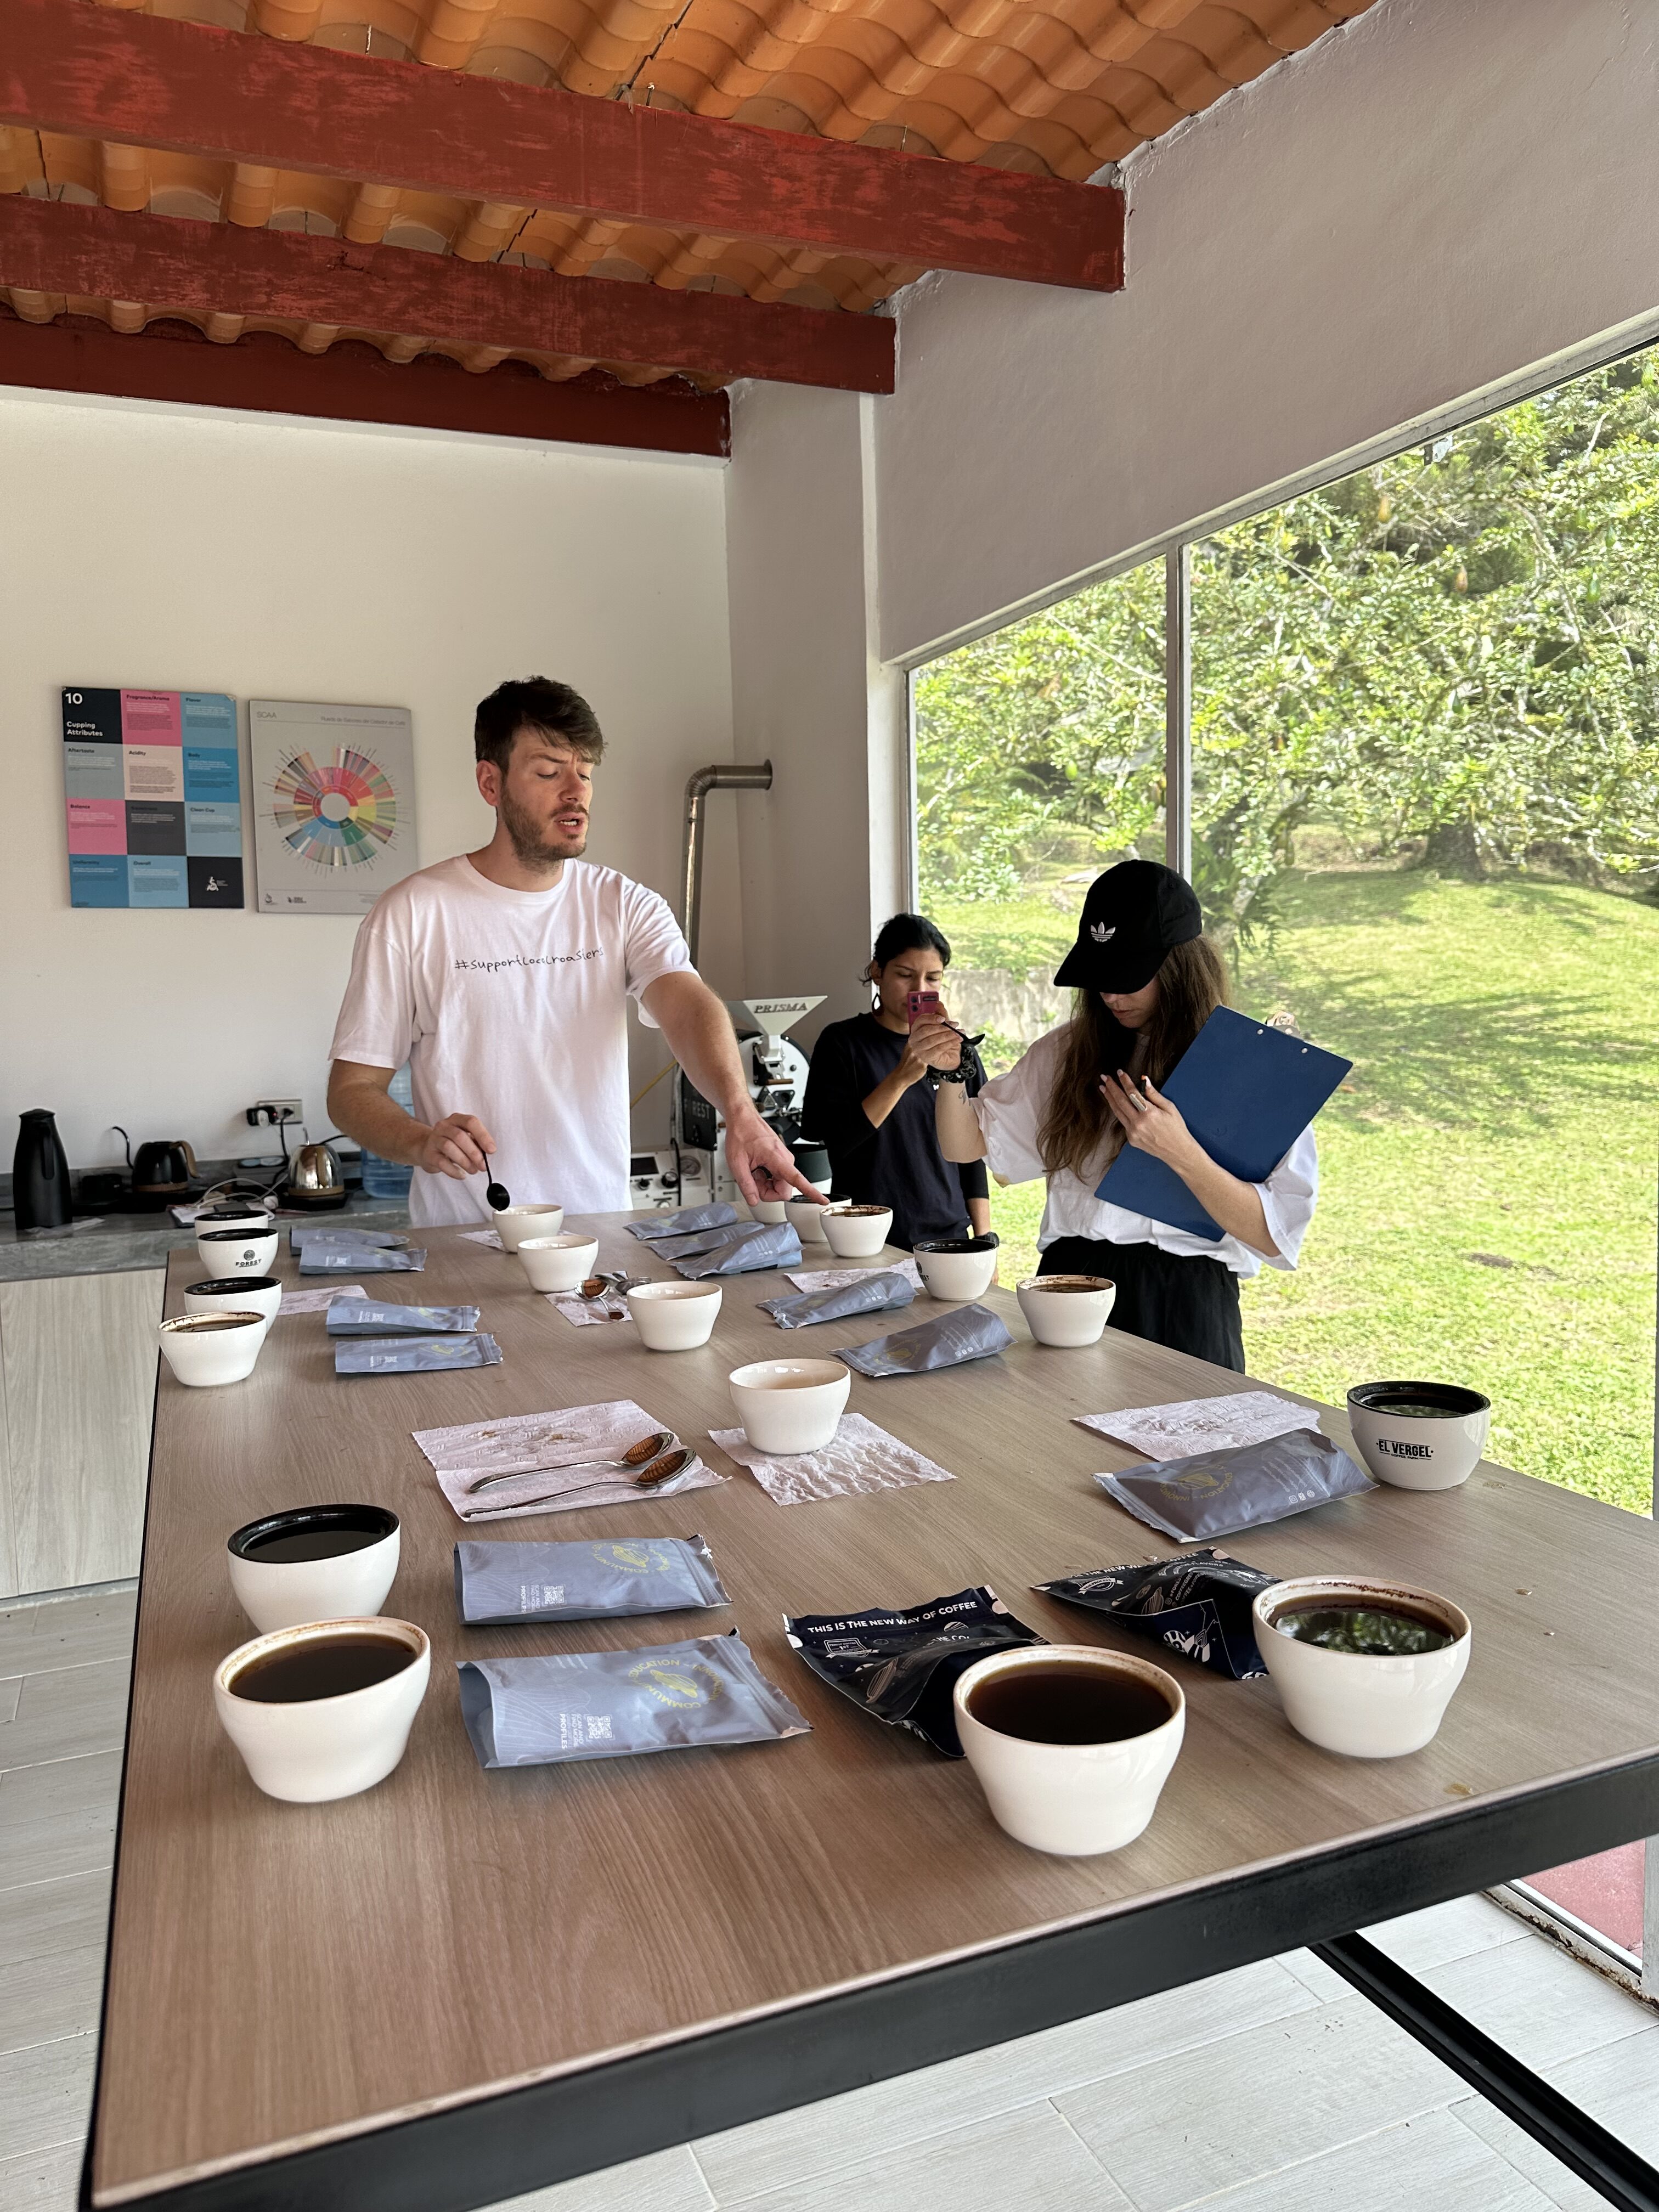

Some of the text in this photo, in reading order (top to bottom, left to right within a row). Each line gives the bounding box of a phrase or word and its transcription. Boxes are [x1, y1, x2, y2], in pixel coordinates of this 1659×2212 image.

[65, 692, 83, 704] 10
[66, 720, 95, 730] Cupping
[67, 729, 104, 737] Attributes
[754, 1002, 808, 1013] PRISMA
[1379, 1440, 1431, 1458] EL VERGEL
[807, 1624, 833, 1633] THIS
[834, 1622, 846, 1630] IS
[846, 1621, 868, 1629] THE
[895, 1617, 919, 1625] WAY
[922, 1610, 936, 1620] OF
[938, 1601, 978, 1615] COFFEE
[628, 1659, 680, 1677] EDUCATION
[560, 1713, 568, 1749] PROFILES
